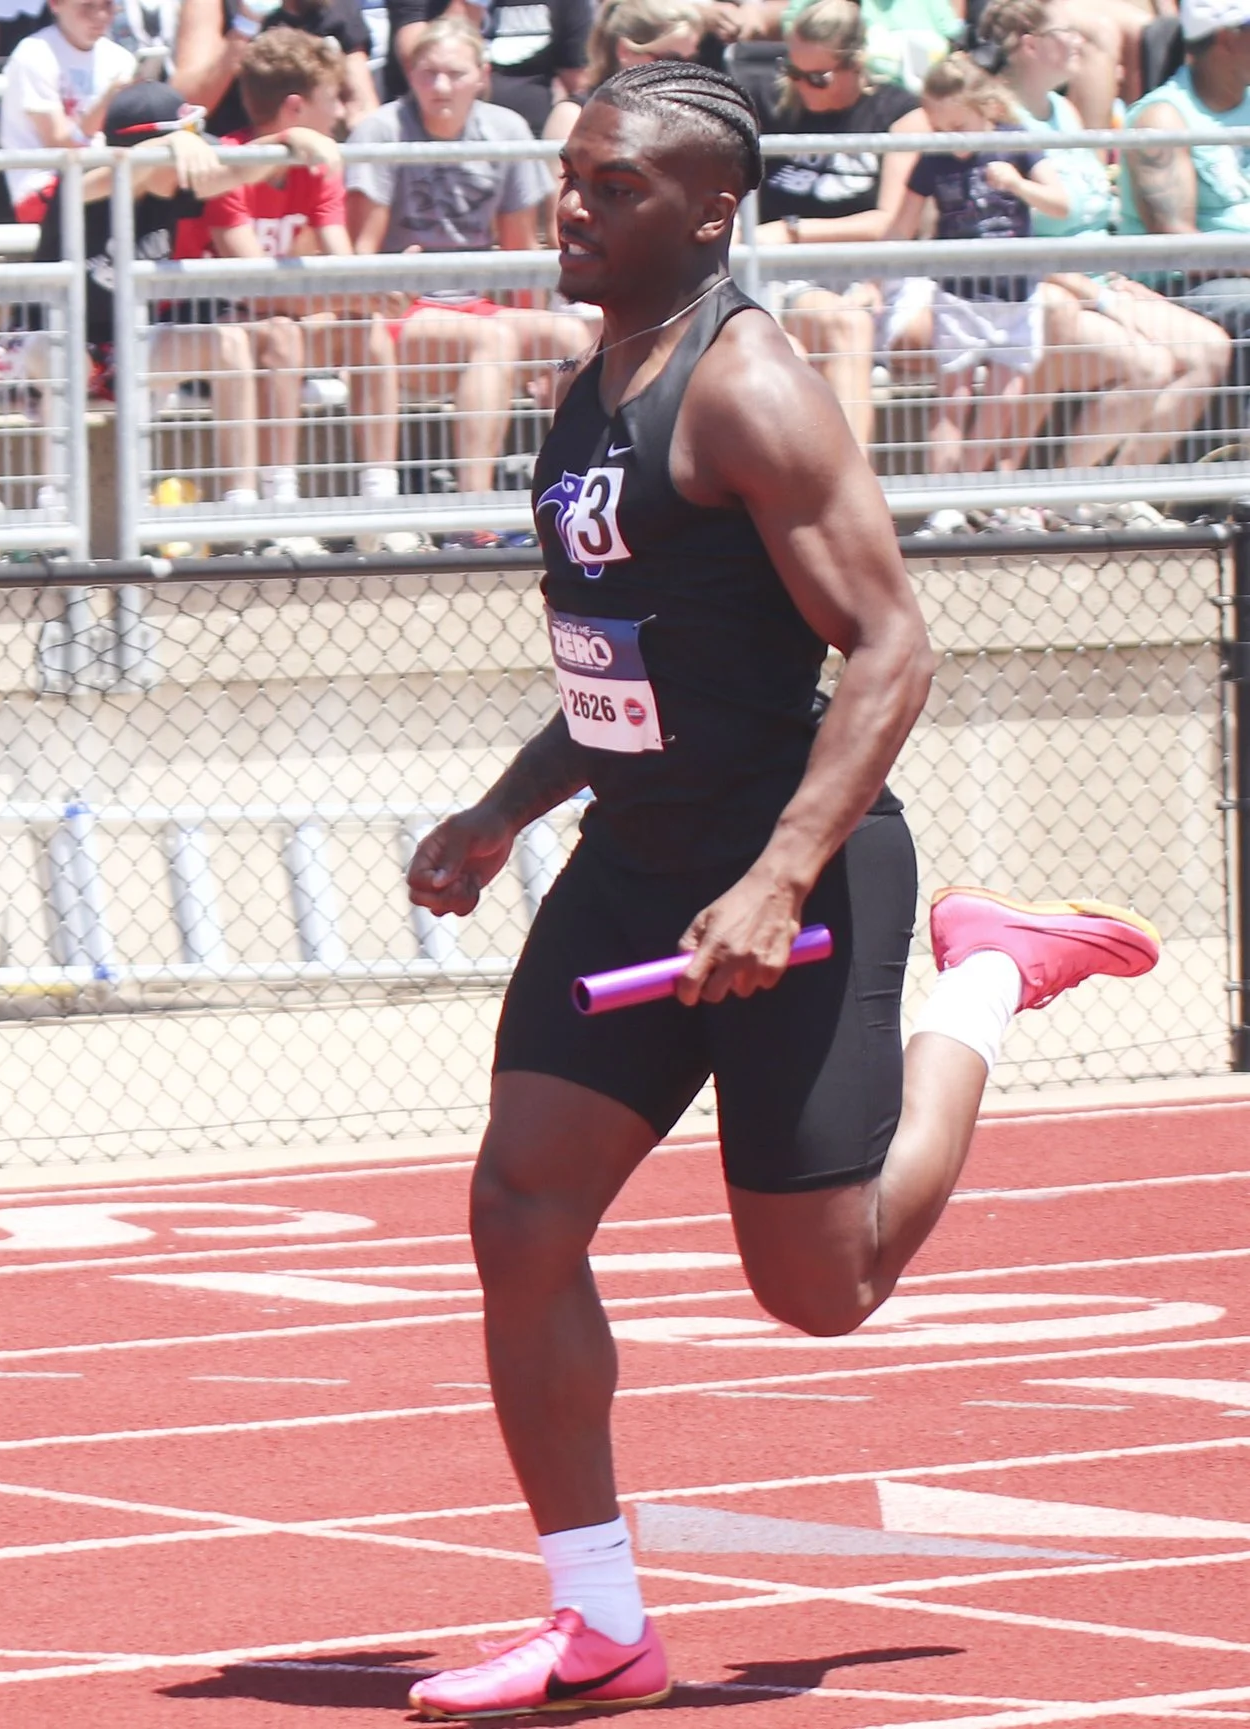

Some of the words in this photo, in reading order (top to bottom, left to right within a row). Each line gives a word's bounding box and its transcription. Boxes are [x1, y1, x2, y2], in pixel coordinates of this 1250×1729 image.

[577, 474, 614, 555] 3
[551, 626, 613, 668] ZERO
[568, 688, 616, 722] 2626
